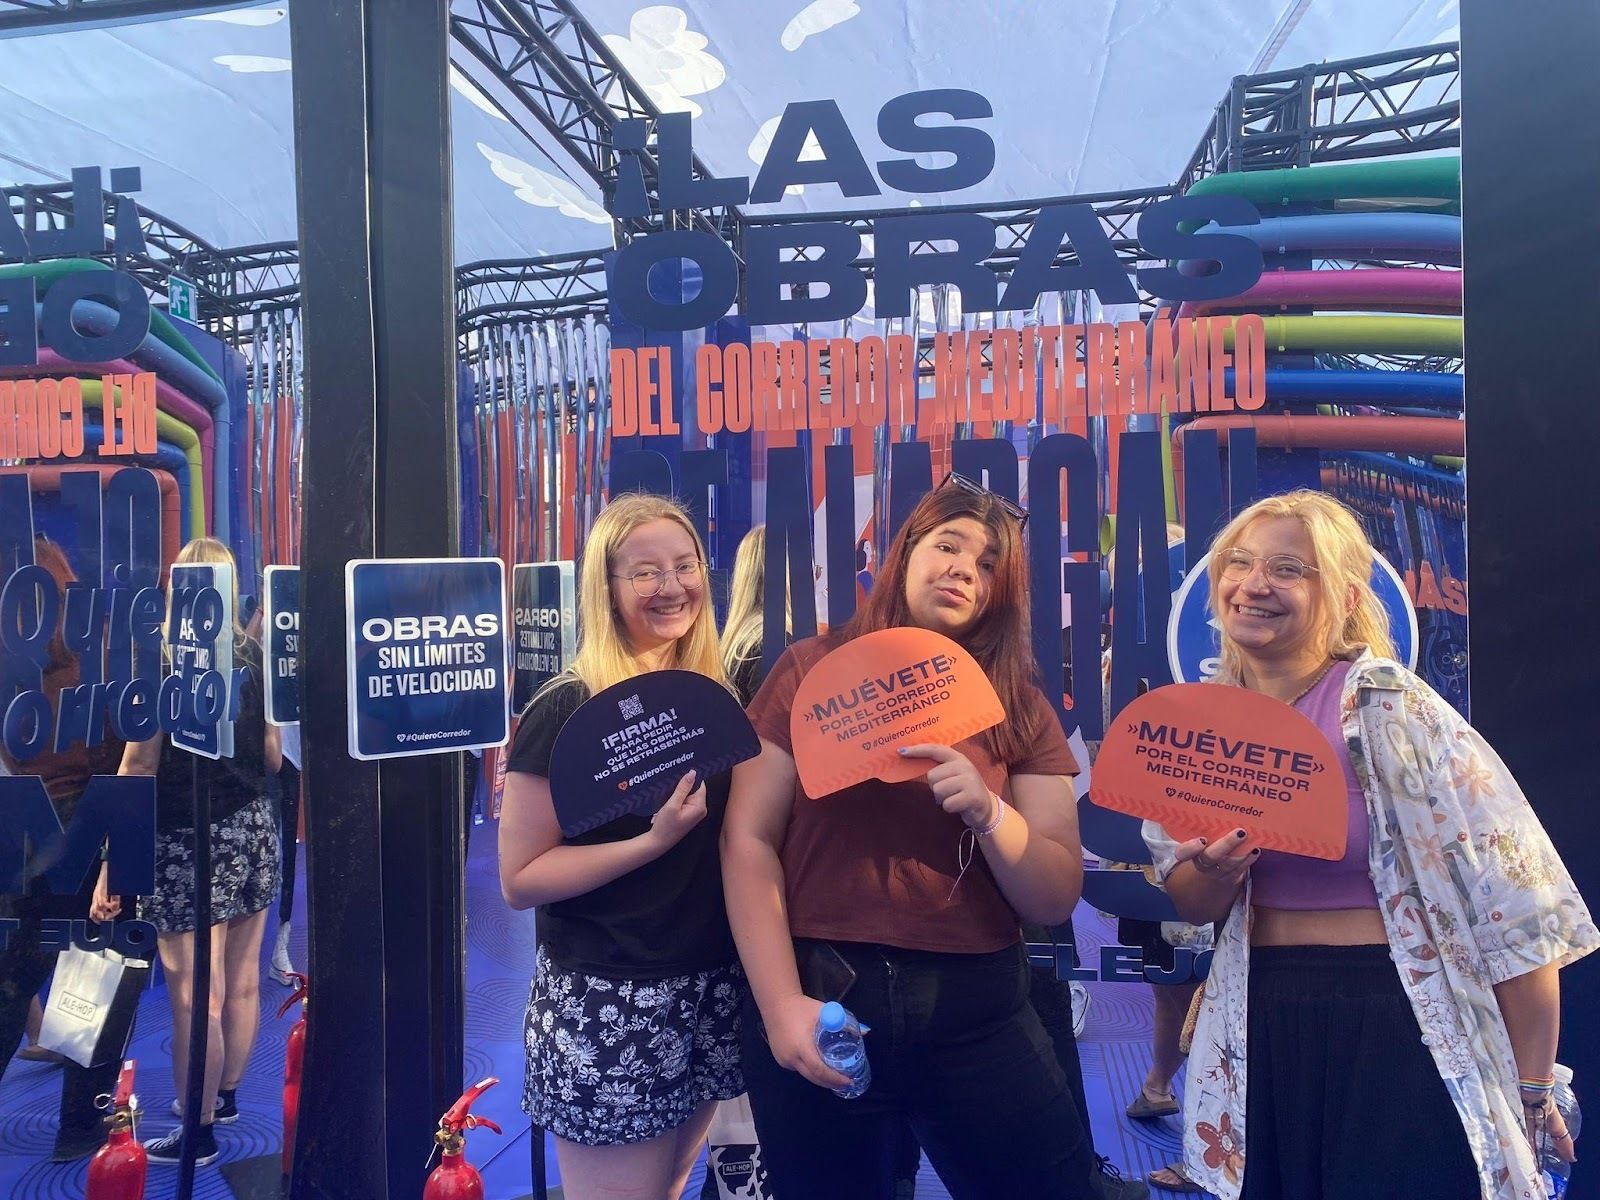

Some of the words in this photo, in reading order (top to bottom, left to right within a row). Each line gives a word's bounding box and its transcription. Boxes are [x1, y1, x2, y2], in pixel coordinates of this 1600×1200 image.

[613, 198, 1264, 331] OBRAS
[610, 346, 680, 438] DEL
[696, 335, 917, 434] CORREDOR
[934, 307, 1266, 423] MEDITERRÁNEO
[362, 613, 498, 642] OBRAS
[378, 646, 410, 669] SIN
[413, 640, 486, 668] LÍMITES
[368, 675, 393, 698] DE
[396, 668, 496, 697] VELOCIDAD
[820, 716, 854, 735] POR
[856, 708, 873, 721] EL
[876, 674, 957, 712] CORREDOR
[836, 690, 951, 742] MEDITERRÁNEO
[406, 729, 471, 742] #QuieroCorredor
[602, 708, 678, 750] ¡FIRMA!
[607, 752, 628, 766] QUE
[630, 743, 649, 756] LAS
[650, 726, 687, 745] OBRAS
[614, 736, 643, 753] PARA
[644, 723, 673, 740] PEDIR
[872, 716, 940, 748] #QuieroCorredor
[594, 769, 611, 782] NO
[611, 763, 626, 773] SE
[627, 738, 680, 766] RETRASEN
[682, 727, 705, 741] MÁS
[628, 751, 695, 787] #QuieroCorredor
[1135, 745, 1172, 762] POR
[1177, 754, 1198, 768] EL
[1202, 759, 1310, 791] CORREDOR
[1146, 761, 1292, 802] MEDITERRÁNEO
[1177, 791, 1264, 818] #QuieroCorredor
